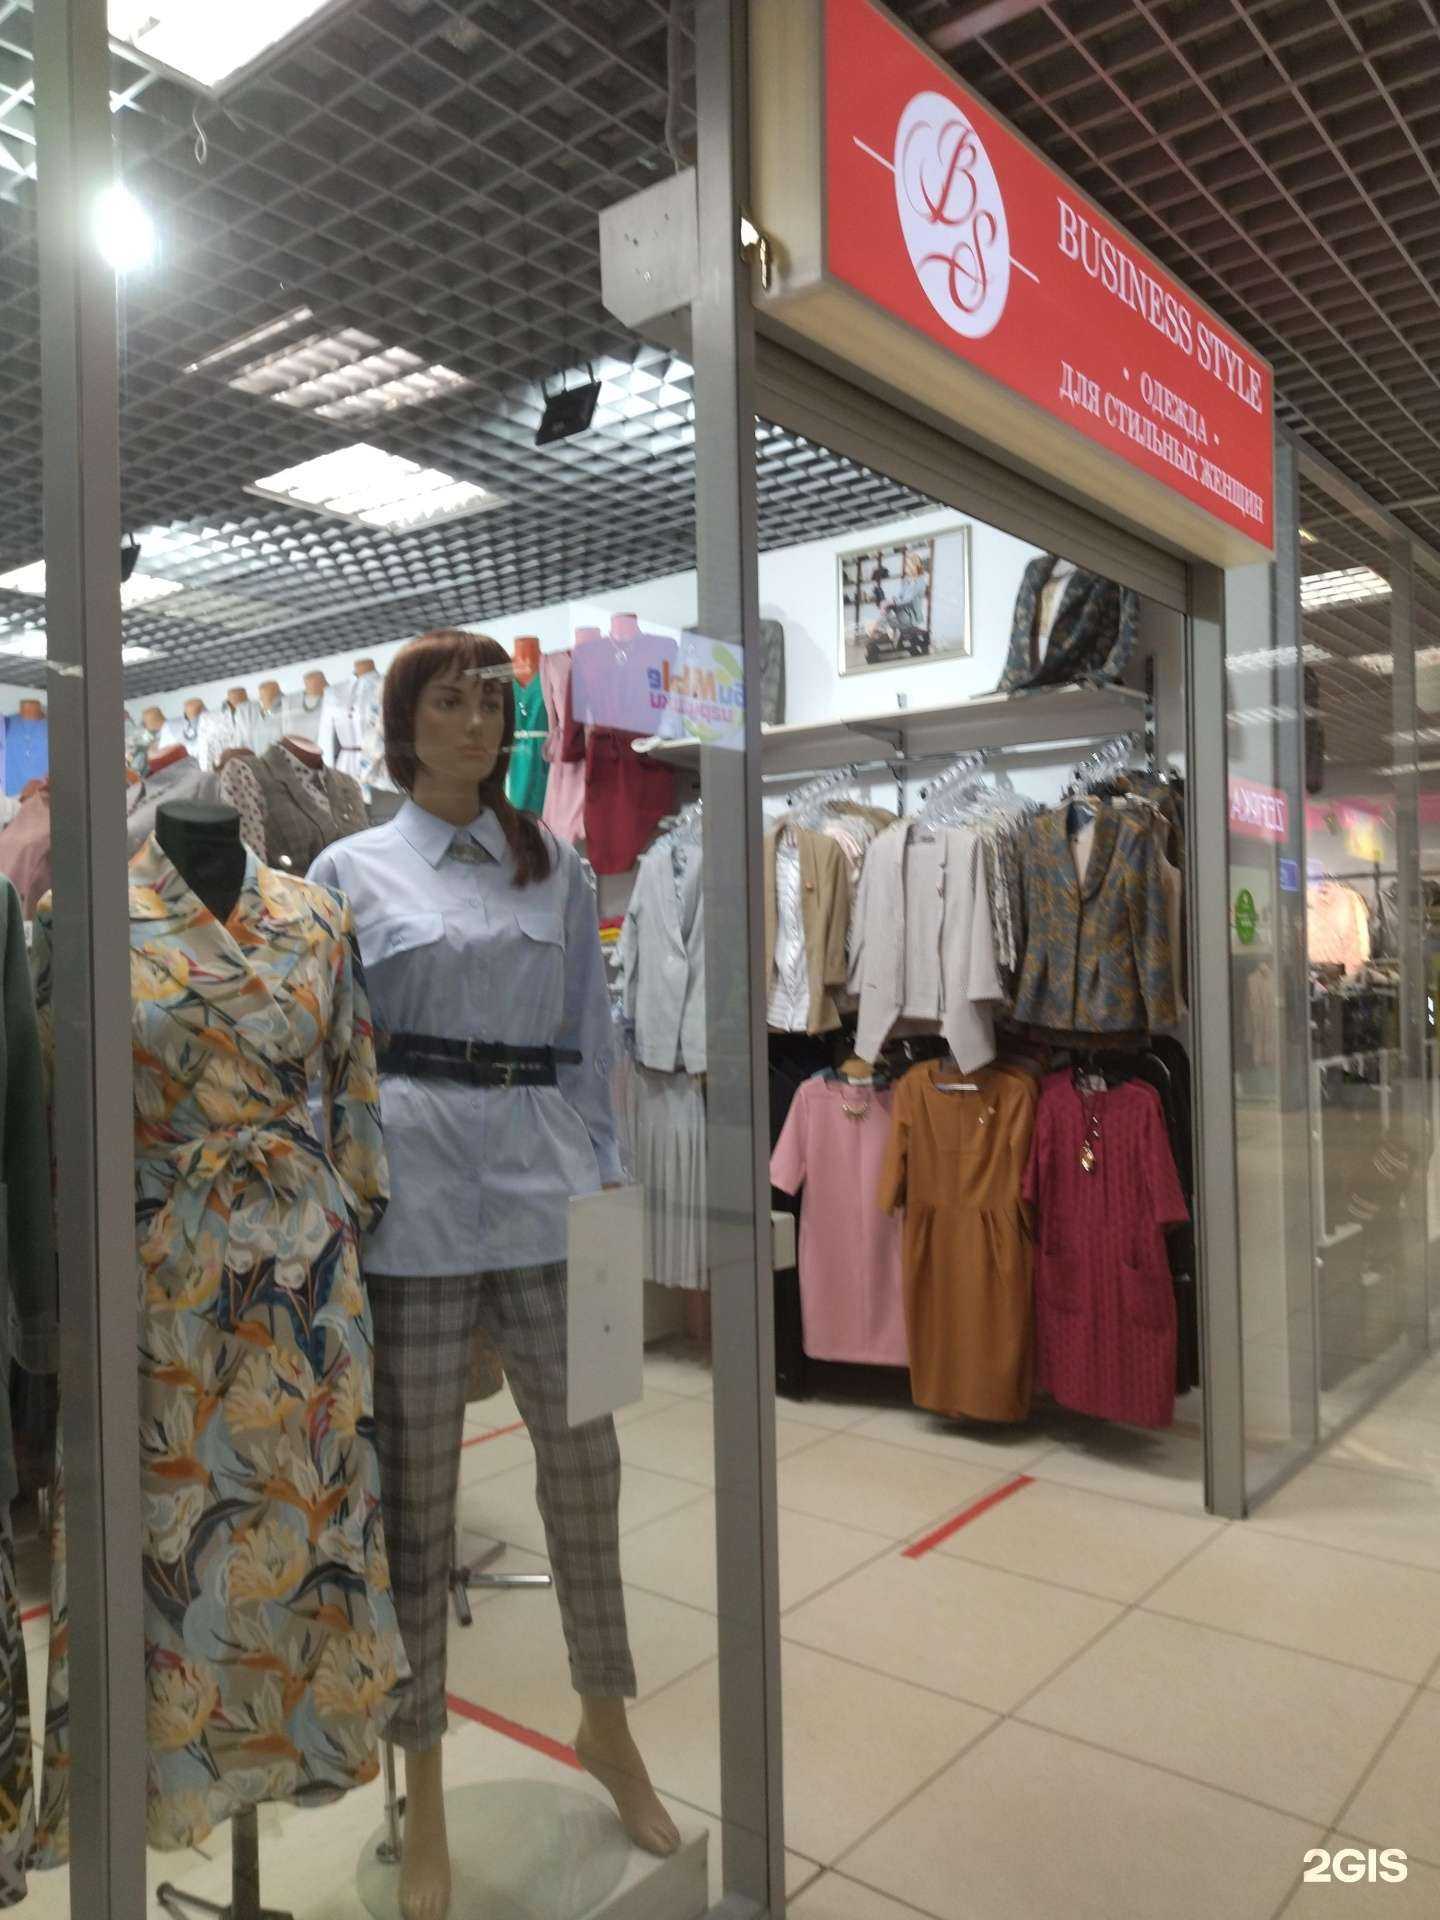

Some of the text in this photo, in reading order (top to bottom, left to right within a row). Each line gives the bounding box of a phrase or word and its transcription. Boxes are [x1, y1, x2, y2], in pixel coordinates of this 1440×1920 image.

[1057, 196, 1263, 415] BUSINESS STYLE
[1060, 360, 1265, 525] ДЛЯ СТИЛЬНЫХ ЖЕНЩИН
[1140, 371, 1208, 446] ОДЕЖДА
